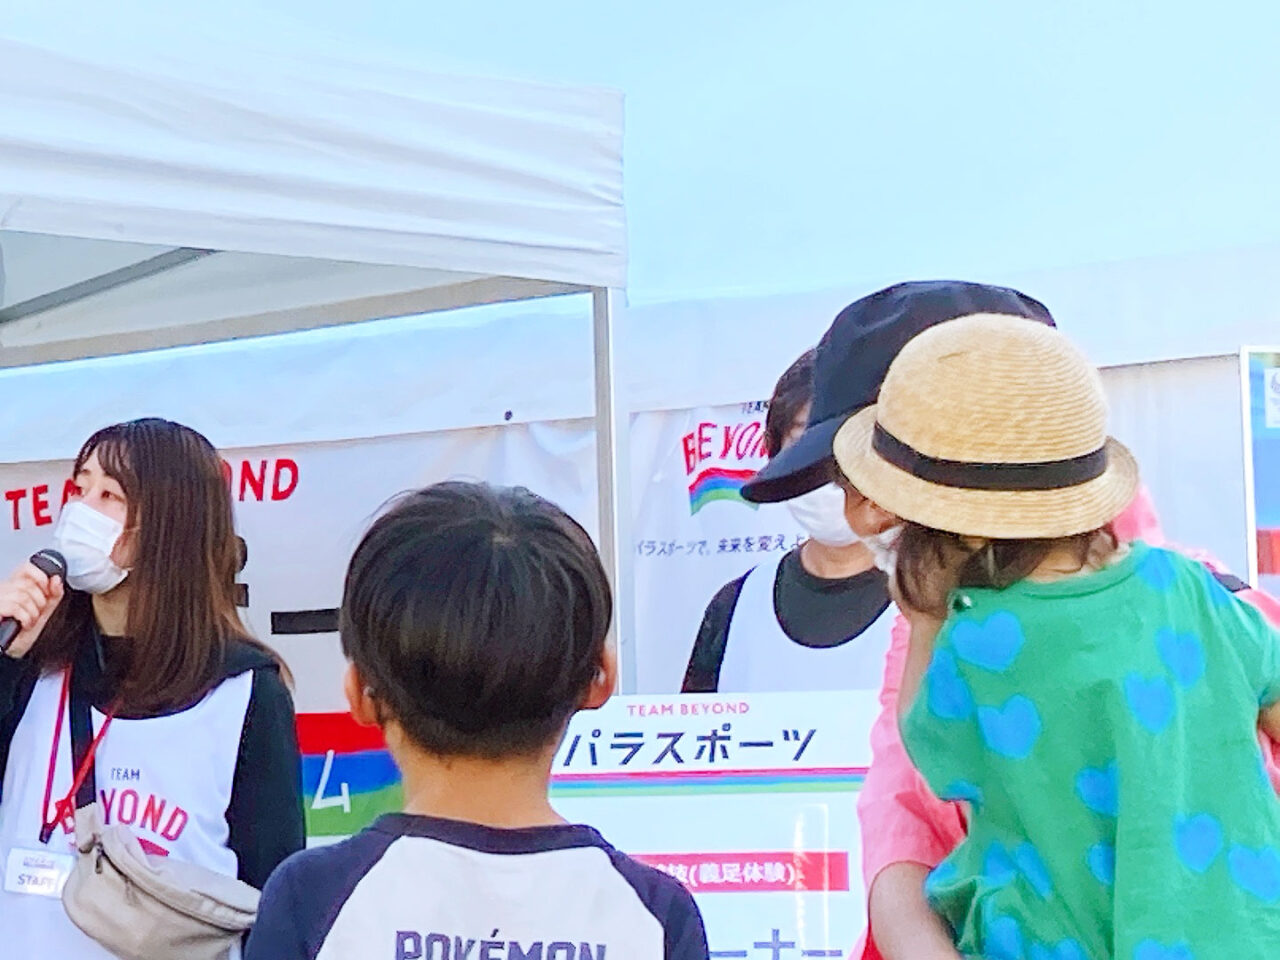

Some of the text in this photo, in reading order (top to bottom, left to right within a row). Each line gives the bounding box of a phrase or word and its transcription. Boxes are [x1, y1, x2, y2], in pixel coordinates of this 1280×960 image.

[627, 702, 750, 717] TEAM BEYOND
[563, 722, 817, 767] パラスポーツ
[111, 767, 141, 782] TEAM
